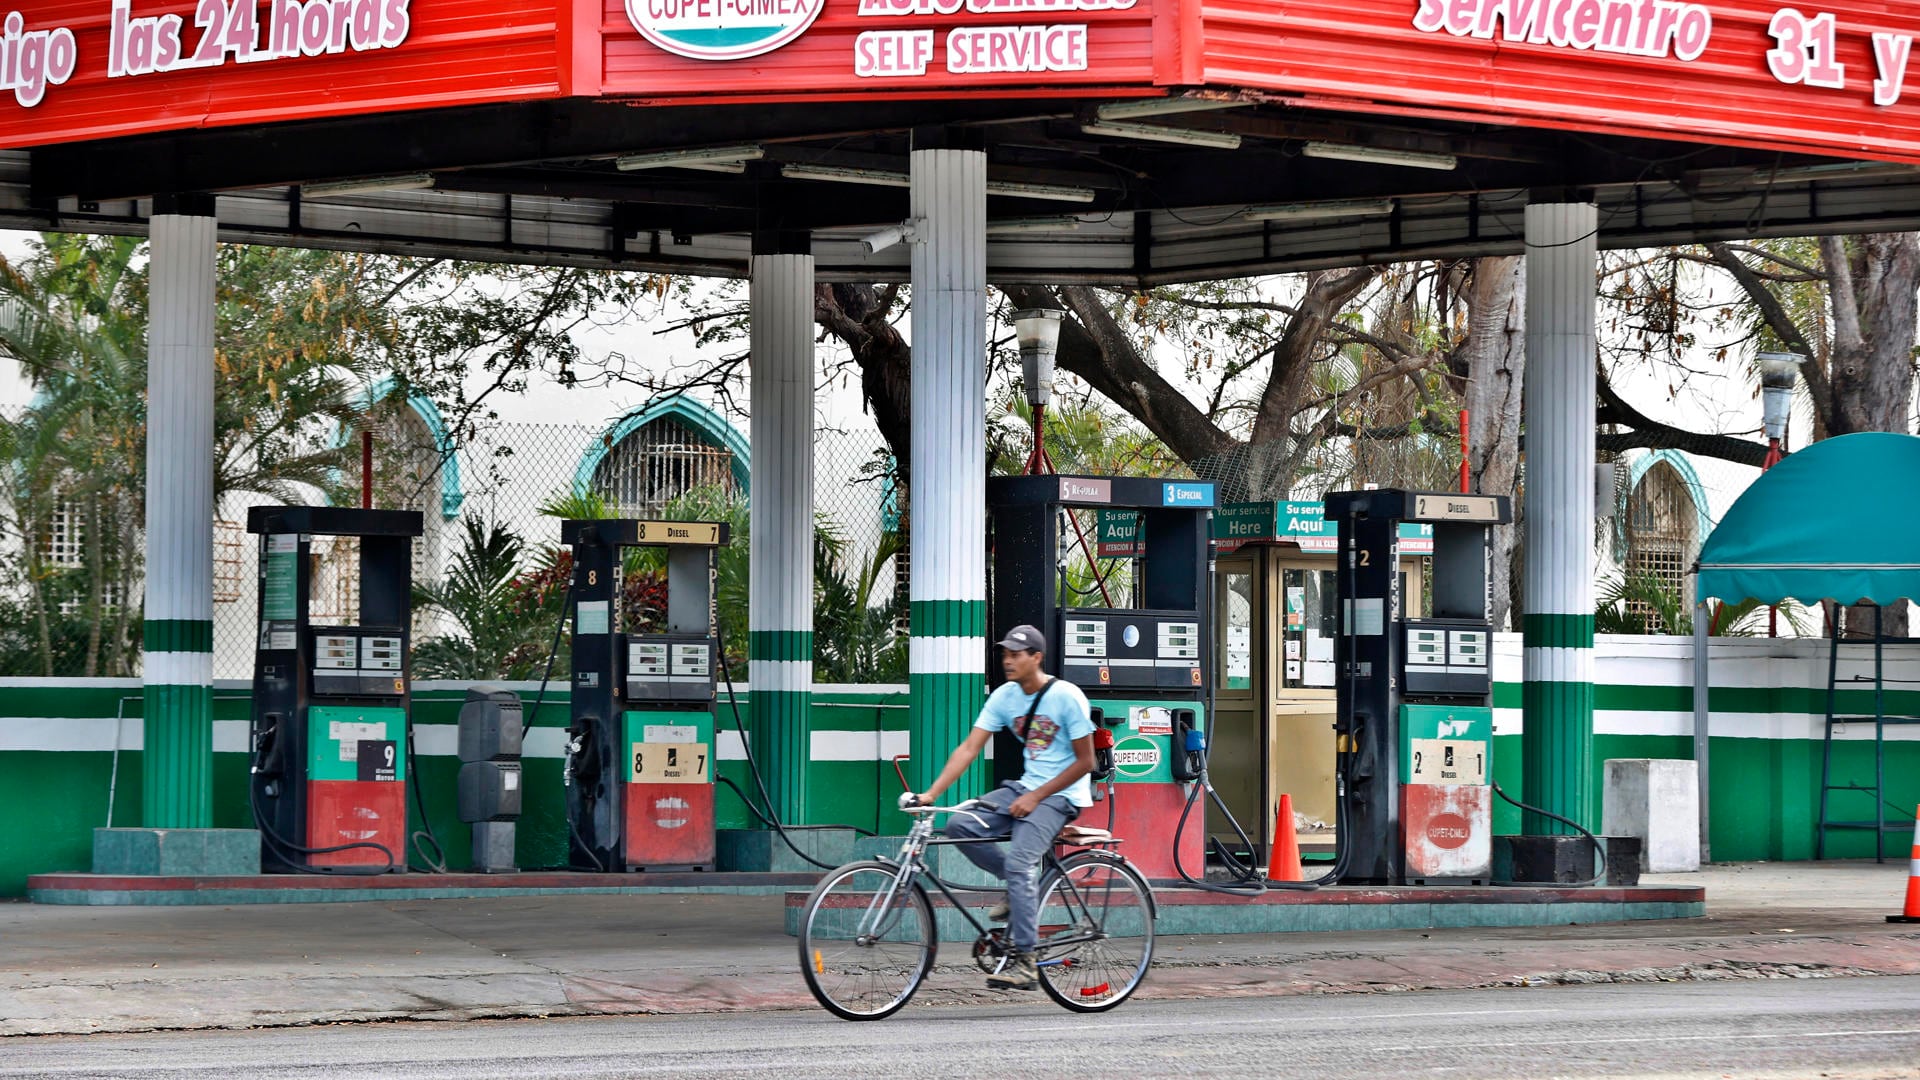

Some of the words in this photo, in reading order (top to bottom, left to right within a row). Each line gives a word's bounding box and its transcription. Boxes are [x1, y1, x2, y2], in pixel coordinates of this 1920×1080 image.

[0, 14, 74, 104] igo
[110, 3, 180, 75] las
[195, 0, 256, 63] 24
[271, 0, 408, 55] horas
[858, 34, 929, 74] SELF
[950, 29, 1084, 70] SERVICE
[1416, 0, 1708, 57] servicentro
[1769, 11, 1842, 85] 31
[1874, 36, 1908, 101] y
[1063, 482, 1070, 499] 5
[1167, 485, 1175, 503] 3
[1105, 511, 1116, 521] Su
[1117, 511, 1138, 521] servi
[1217, 506, 1236, 516] Your
[1286, 504, 1299, 514] Su
[1300, 503, 1325, 514] servi
[1419, 498, 1426, 515] 2
[1448, 502, 1470, 513] DIESEL
[1490, 501, 1495, 517] 1
[639, 523, 646, 540] 8
[667, 527, 689, 538] DIESEL
[711, 526, 717, 542] 7
[1229, 520, 1261, 534] Here
[1288, 517, 1324, 532] Aquí
[1360, 549, 1370, 567] 2
[588, 570, 597, 586] 8
[384, 745, 395, 768] 9
[635, 752, 643, 773] 8
[664, 769, 681, 778] DIESEL
[697, 754, 705, 775] 7
[1113, 751, 1158, 763] CUPET-CIMEX
[1414, 751, 1422, 774] 2
[1476, 753, 1482, 775] 1
